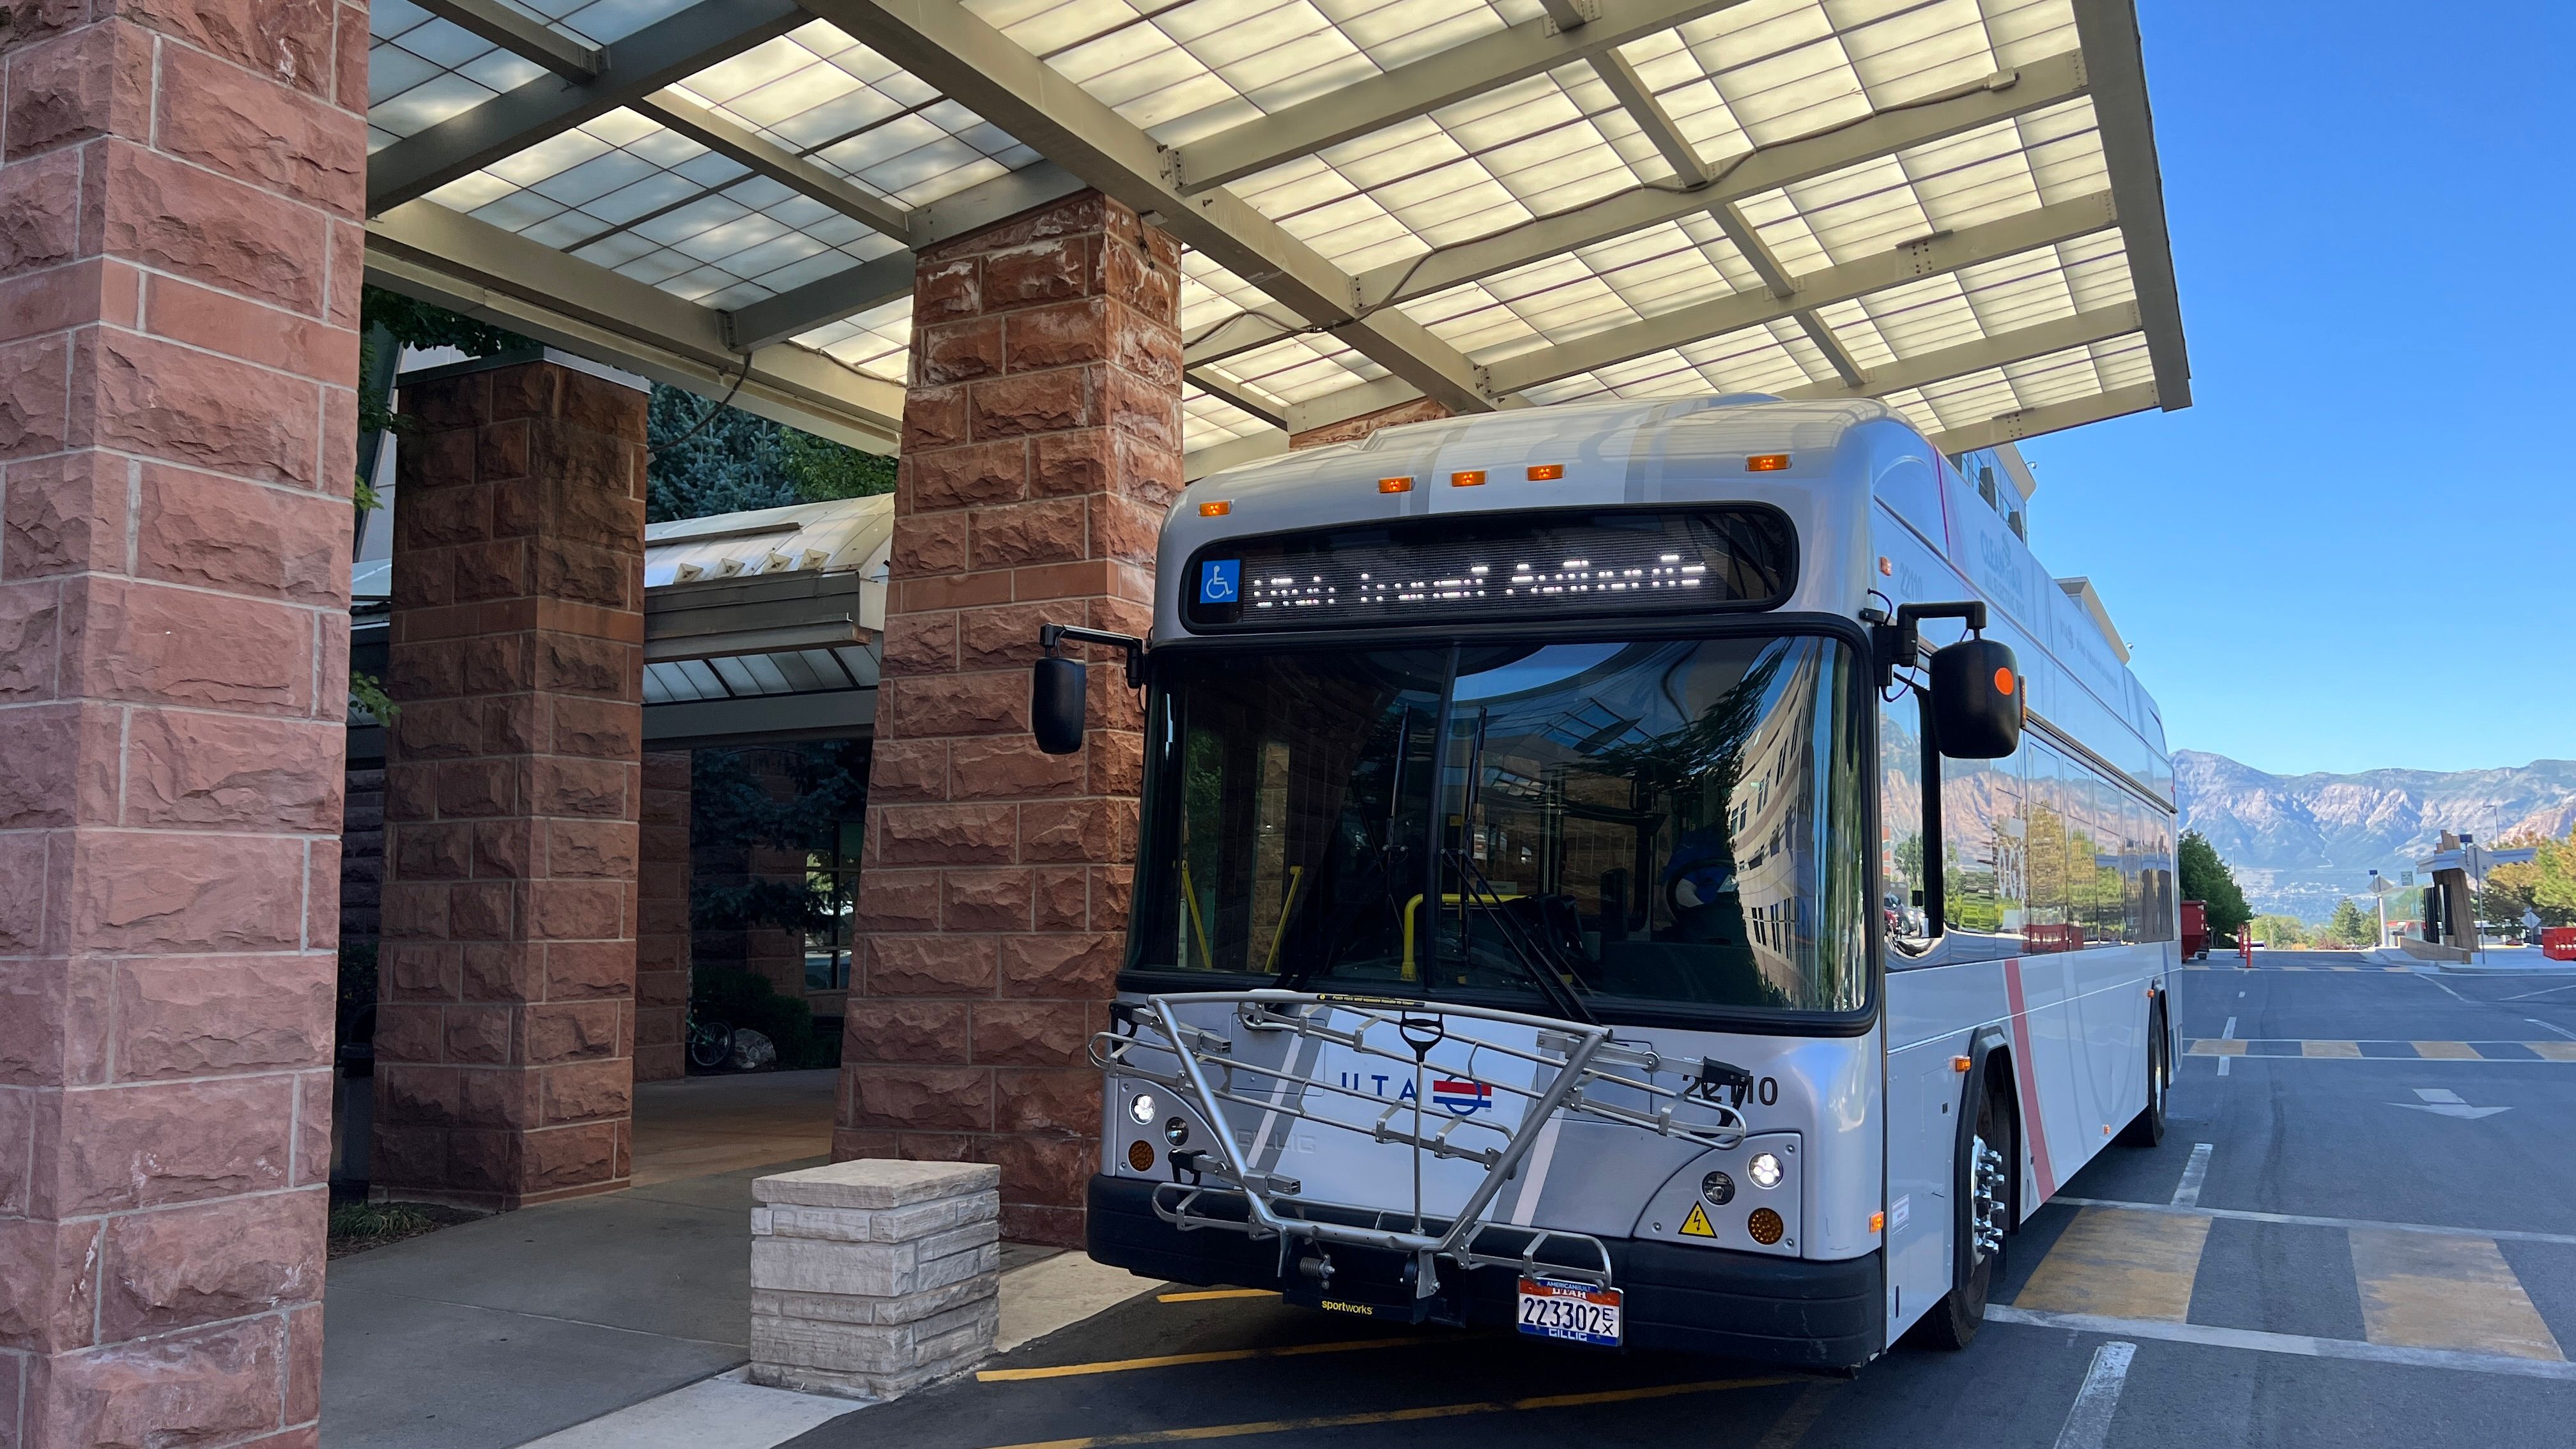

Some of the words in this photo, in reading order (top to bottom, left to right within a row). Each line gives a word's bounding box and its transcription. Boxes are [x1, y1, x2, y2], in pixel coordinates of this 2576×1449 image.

[1342, 1072, 1418, 1102] UTA
[1552, 1287, 1586, 1300] UTAH
[1524, 1297, 1600, 1333] 223302
[1548, 1328, 1588, 1342] GILLIG
